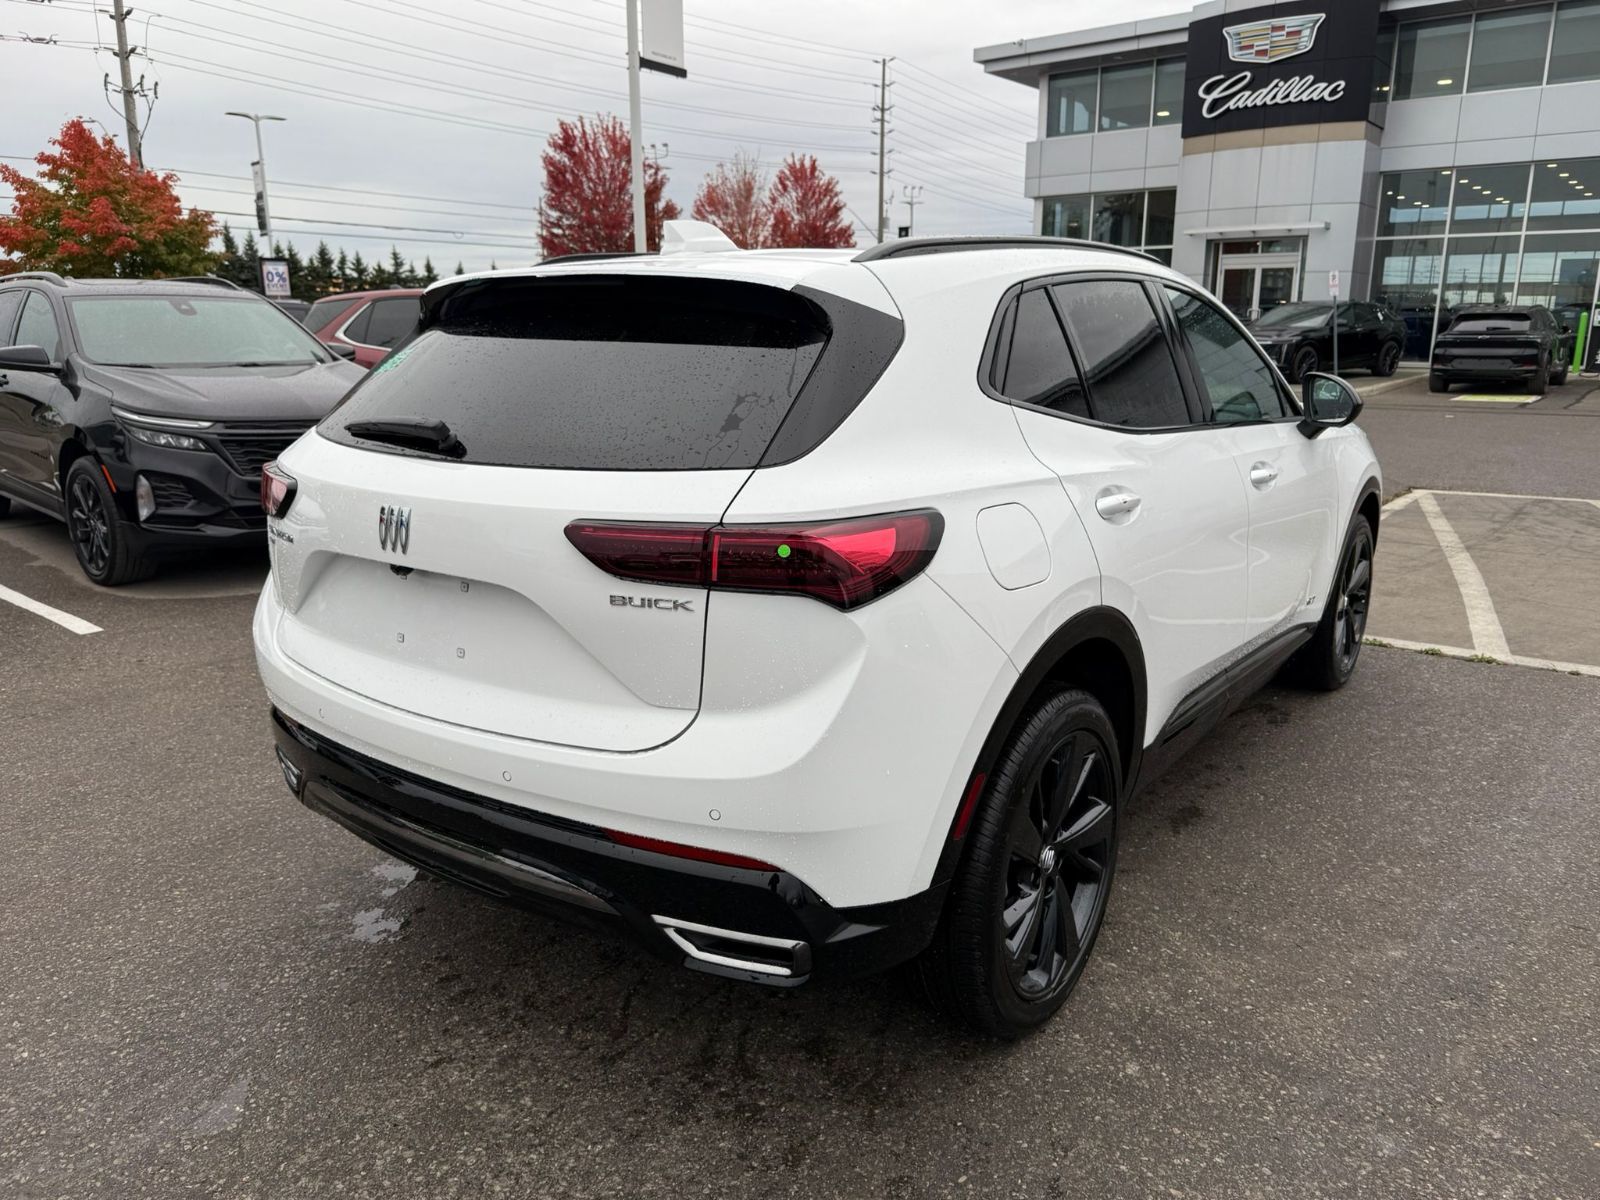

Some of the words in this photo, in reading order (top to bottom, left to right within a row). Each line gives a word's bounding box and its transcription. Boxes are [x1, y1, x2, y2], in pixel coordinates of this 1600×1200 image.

[1198, 71, 1346, 119] Cadillac
[266, 271, 287, 283] 0%
[609, 594, 695, 612] BUICK
